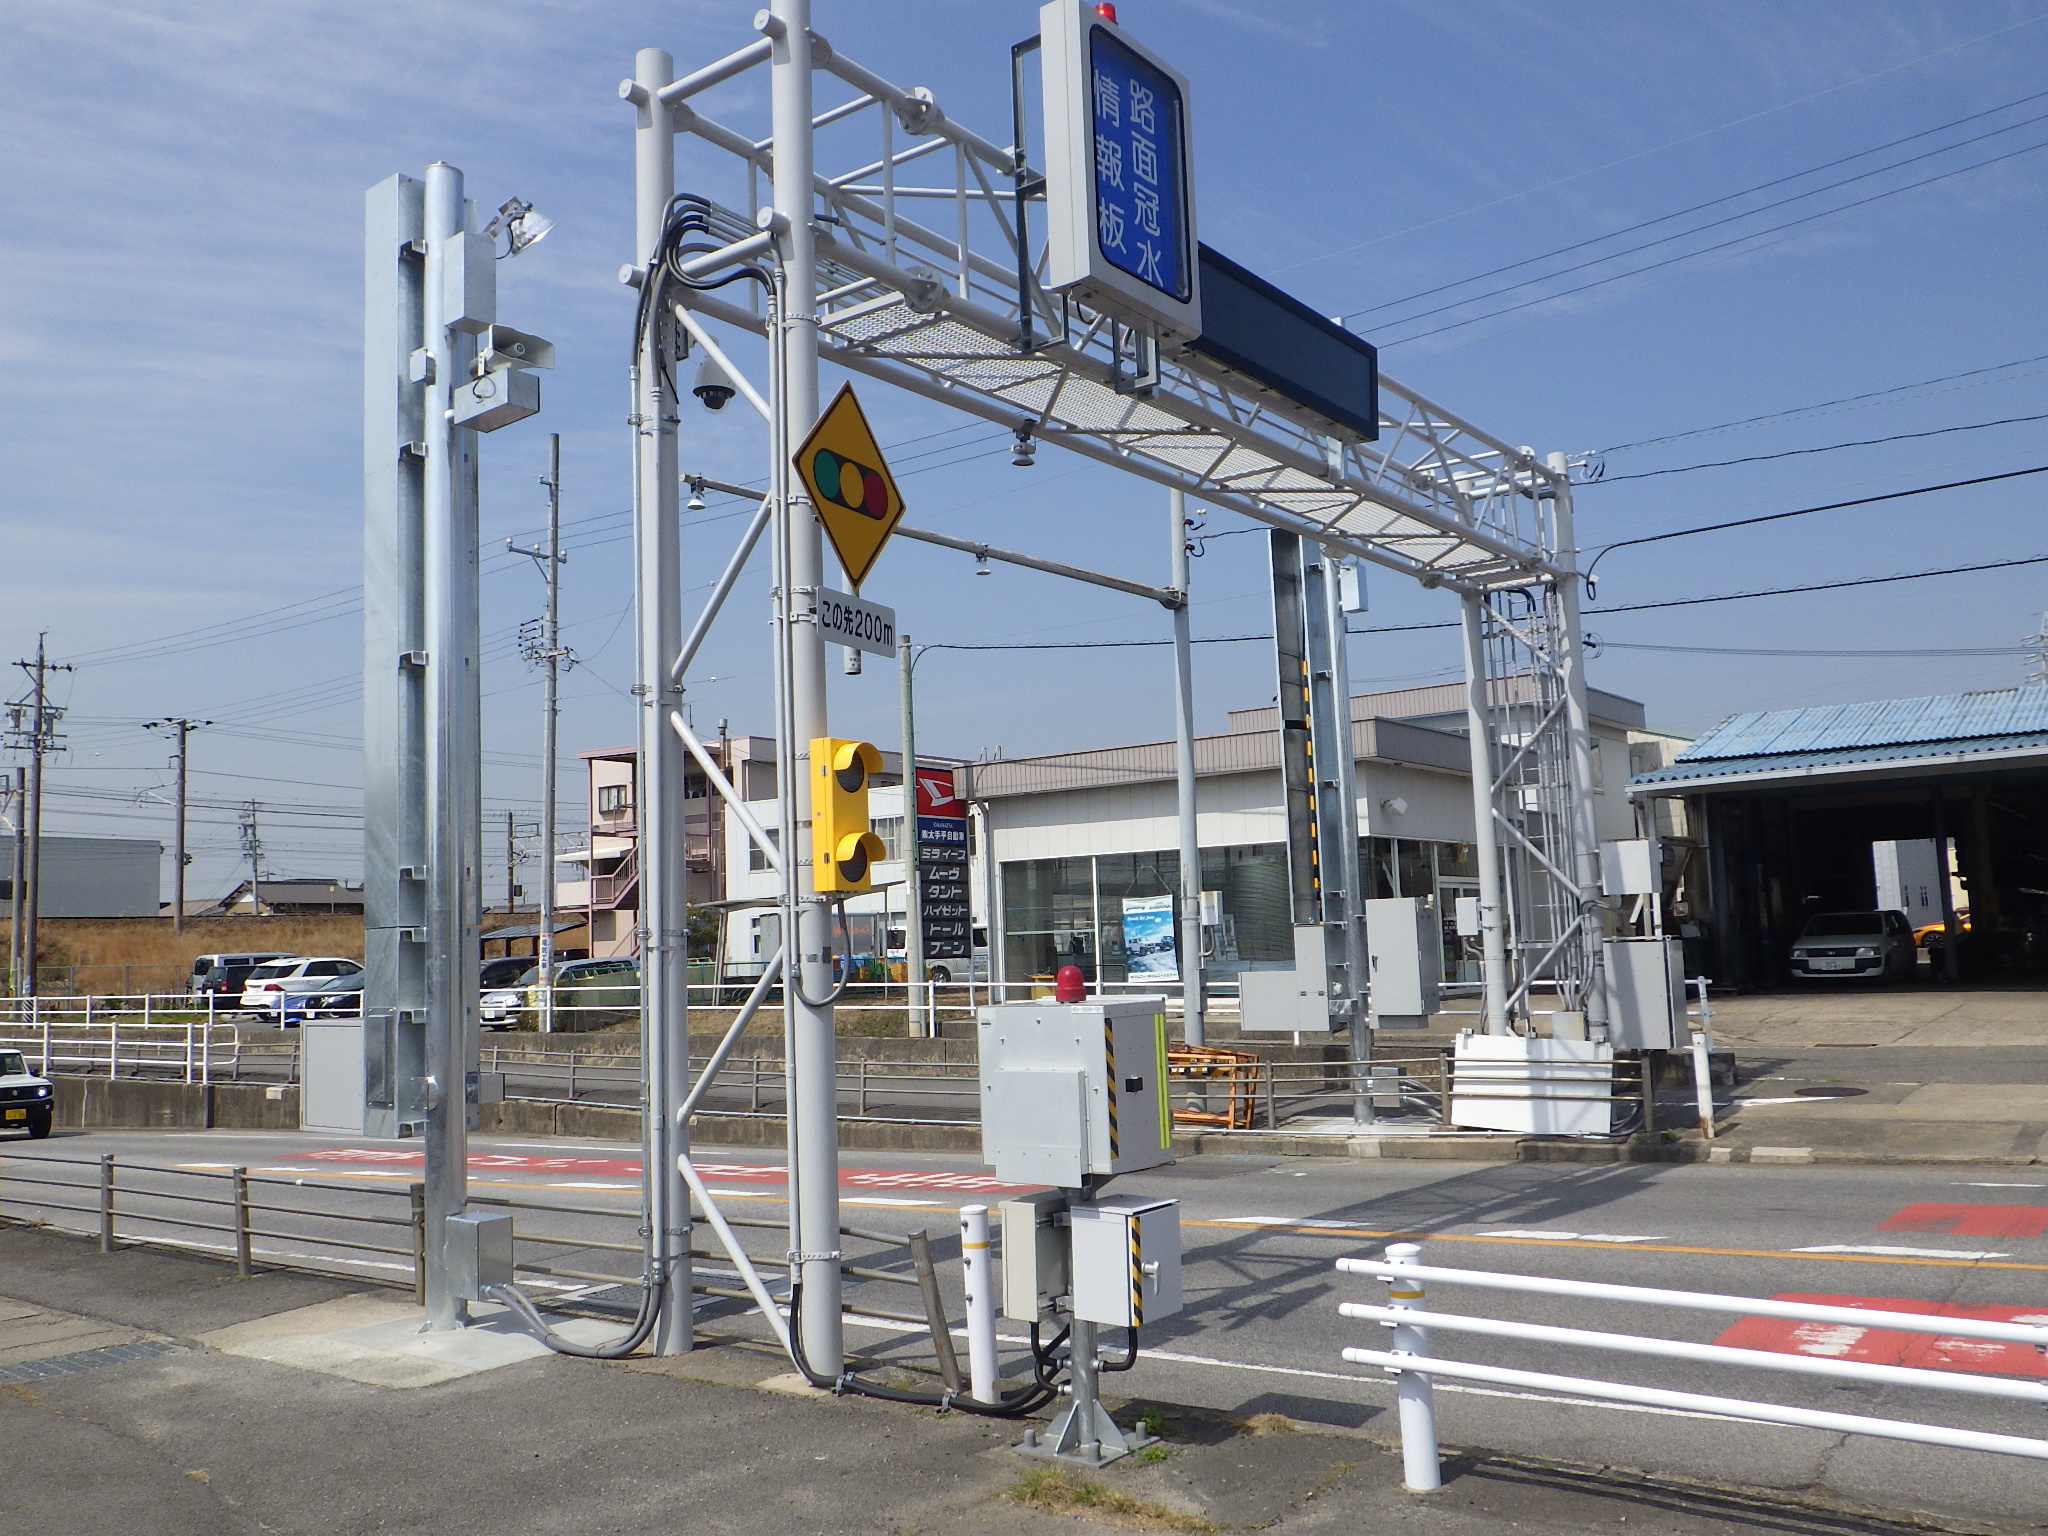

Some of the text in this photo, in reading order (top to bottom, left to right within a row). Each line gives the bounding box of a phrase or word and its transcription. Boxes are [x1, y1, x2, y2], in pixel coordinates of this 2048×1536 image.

[1094, 69, 1128, 255] 情報板
[1129, 78, 1164, 288] 路面冠水
[822, 600, 893, 647] この先200m
[929, 866, 960, 880] ムーヴ
[928, 885, 962, 899] タント
[924, 905, 968, 916] ハイゼット
[930, 922, 964, 936] トール
